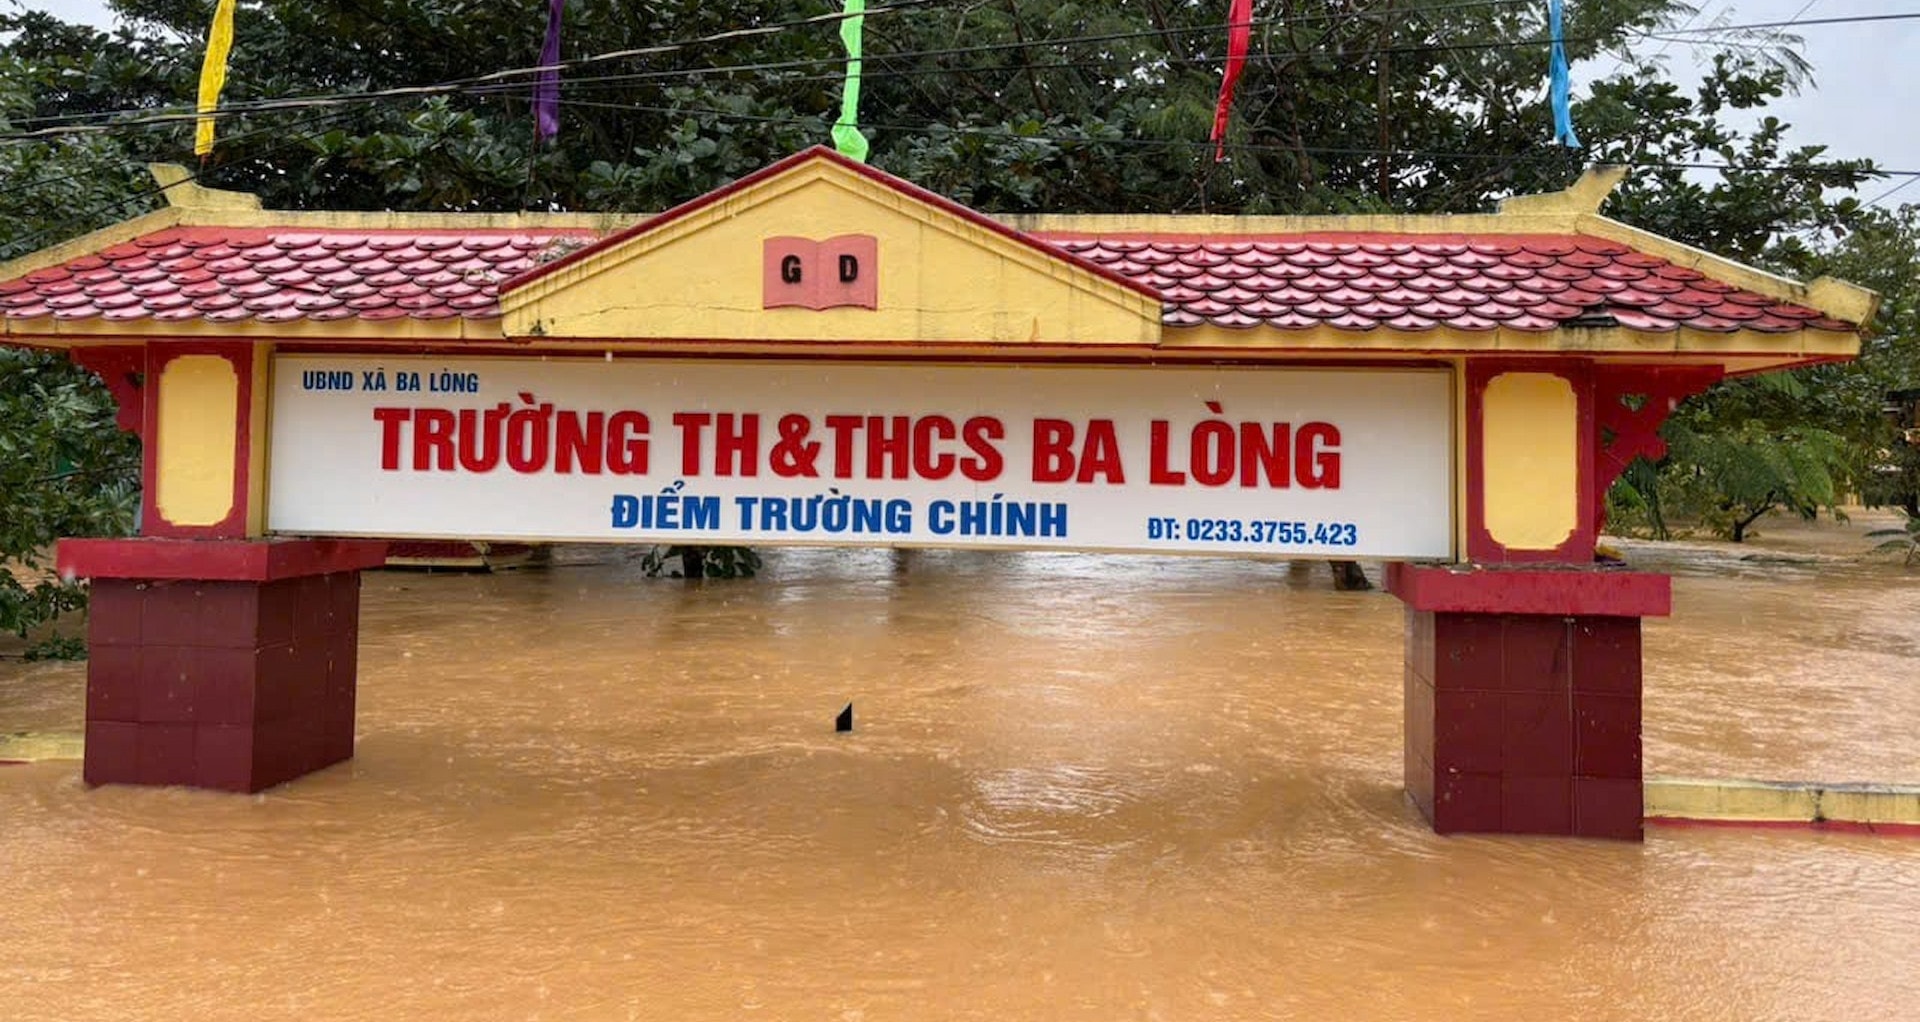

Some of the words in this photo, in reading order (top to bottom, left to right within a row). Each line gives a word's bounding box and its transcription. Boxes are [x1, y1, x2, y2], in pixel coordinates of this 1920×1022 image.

[781, 254, 802, 284] G
[838, 254, 858, 283] D
[303, 370, 353, 390] UBND
[362, 367, 386, 391] XÃ
[396, 372, 421, 391] BA
[429, 368, 478, 392] LÒNG
[373, 391, 651, 477] TRƯỜNG
[672, 412, 1007, 483] TH&THCS
[1031, 418, 1127, 486] BA
[1149, 400, 1342, 491] LÒNG
[611, 481, 721, 531] ĐIỂM
[735, 488, 913, 535] TRƯỜNG
[928, 493, 1068, 539] CHÍNH
[1147, 516, 1180, 541] ĐT:
[1186, 518, 1359, 548] 0233.3755.423
